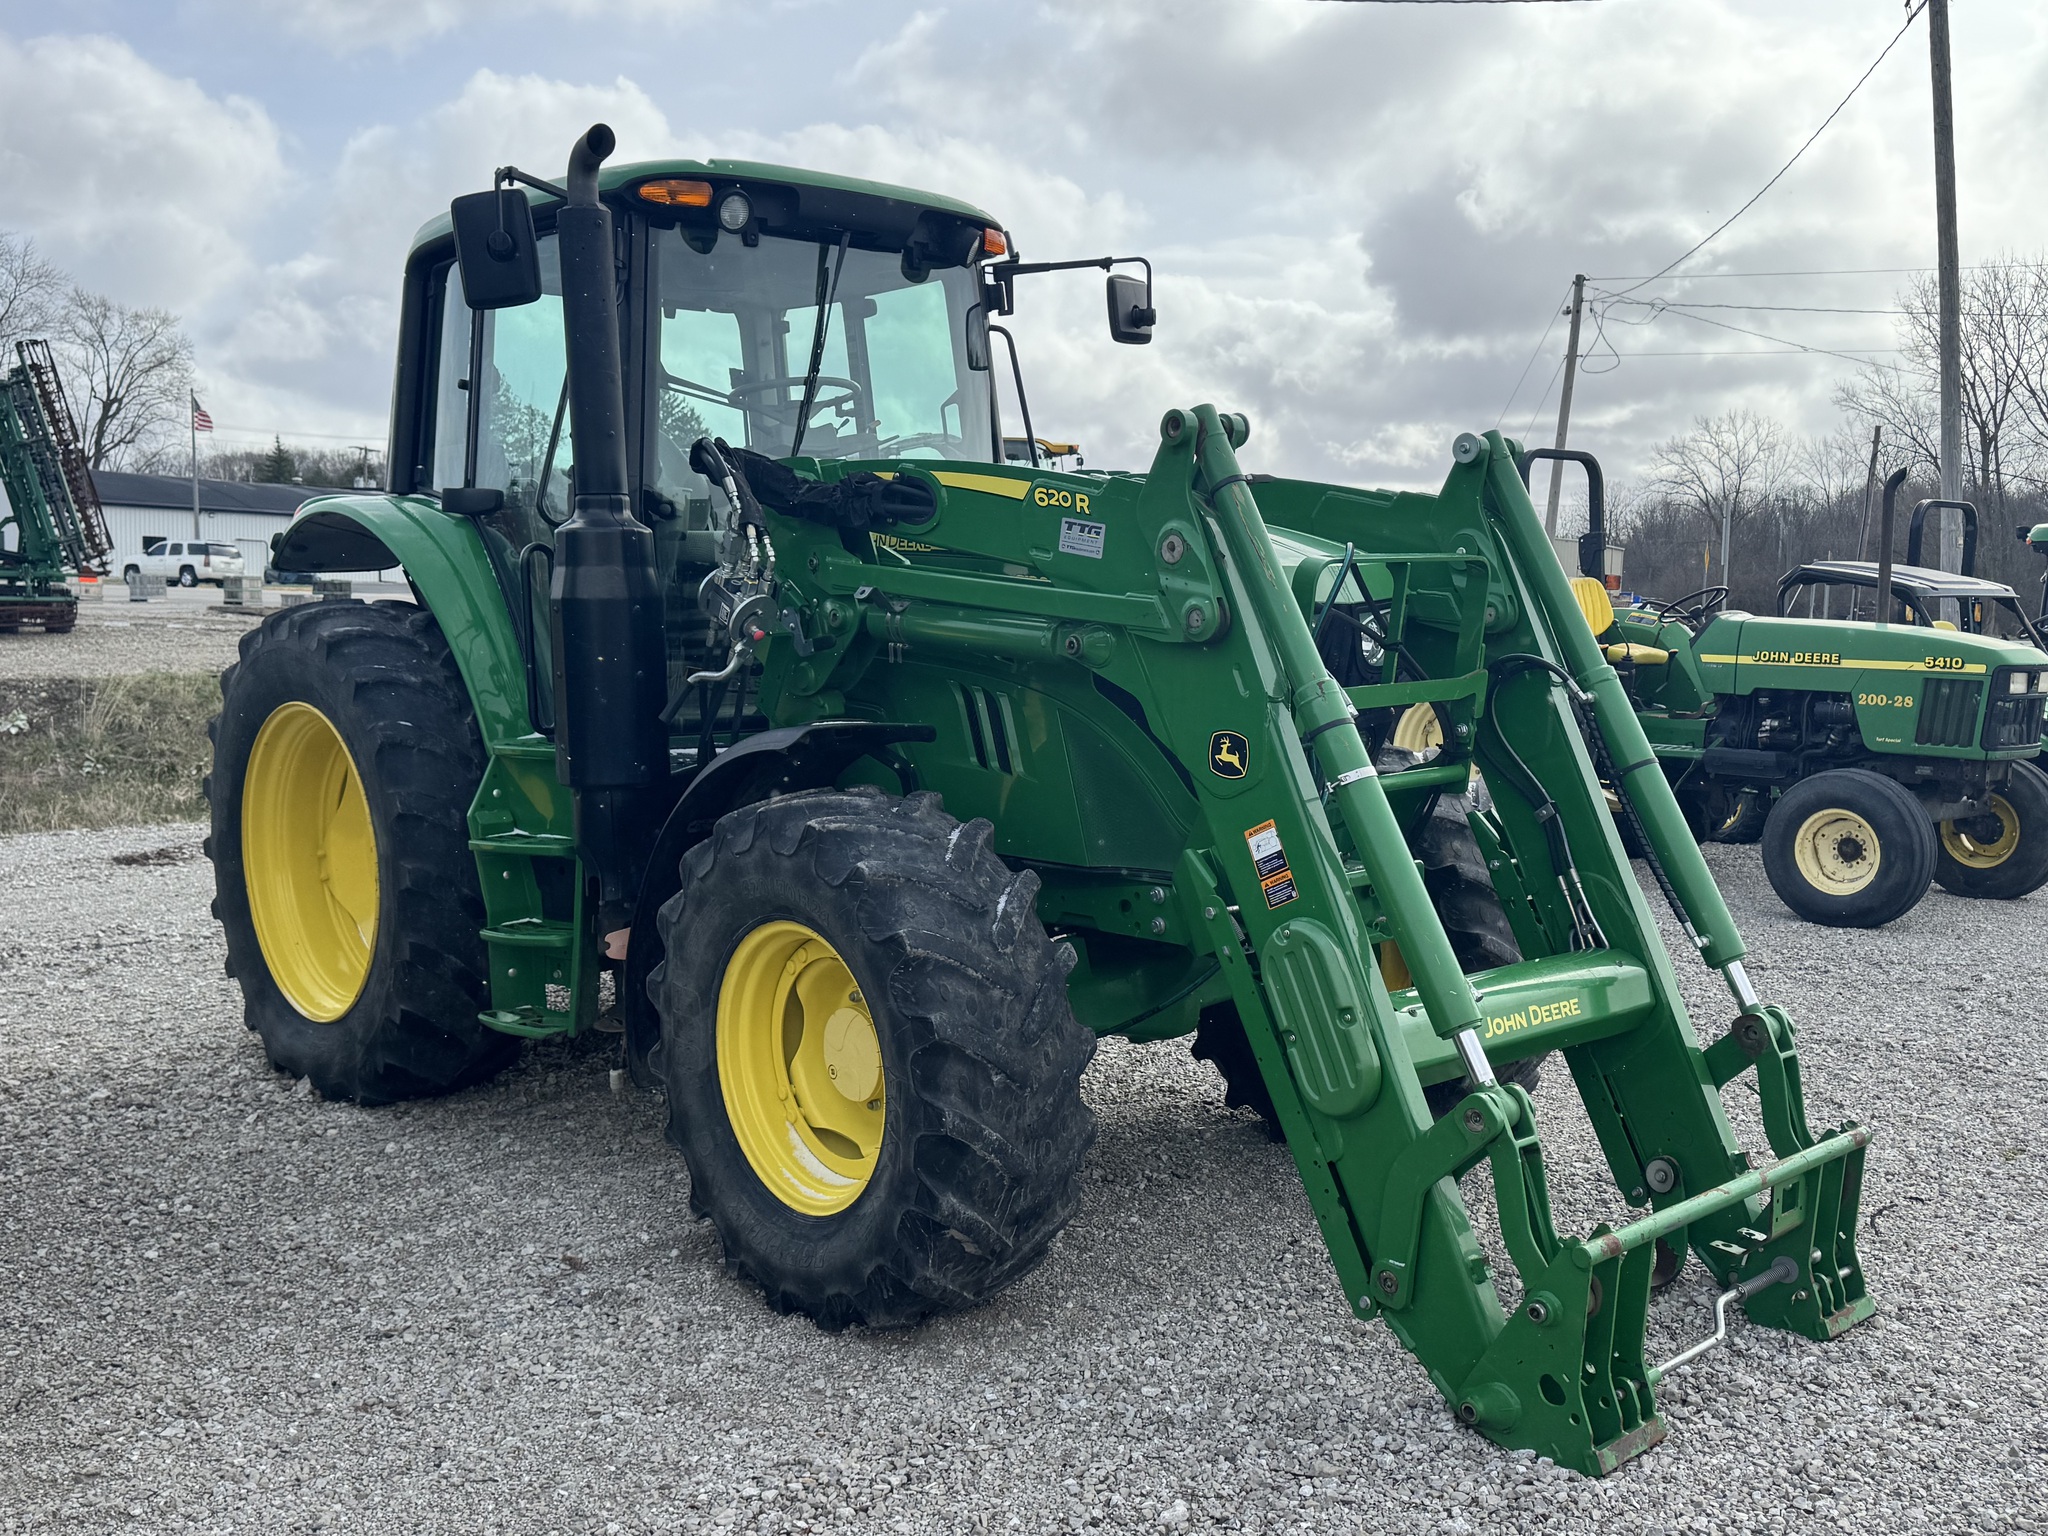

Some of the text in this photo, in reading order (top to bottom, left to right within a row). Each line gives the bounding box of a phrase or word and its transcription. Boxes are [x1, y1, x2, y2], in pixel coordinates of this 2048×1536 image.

[1033, 487, 1092, 515] 620 R
[1064, 520, 1103, 540] TTG
[1063, 535, 1098, 546] EQUIPMENT
[1752, 650, 1841, 665] JOHN DEERE
[1923, 656, 1965, 670] 5410
[1858, 693, 1914, 708] 200-28
[1253, 822, 1272, 834] WARNING
[1269, 873, 1289, 885] WARNING
[1484, 998, 1582, 1040] JOHN DEERE
